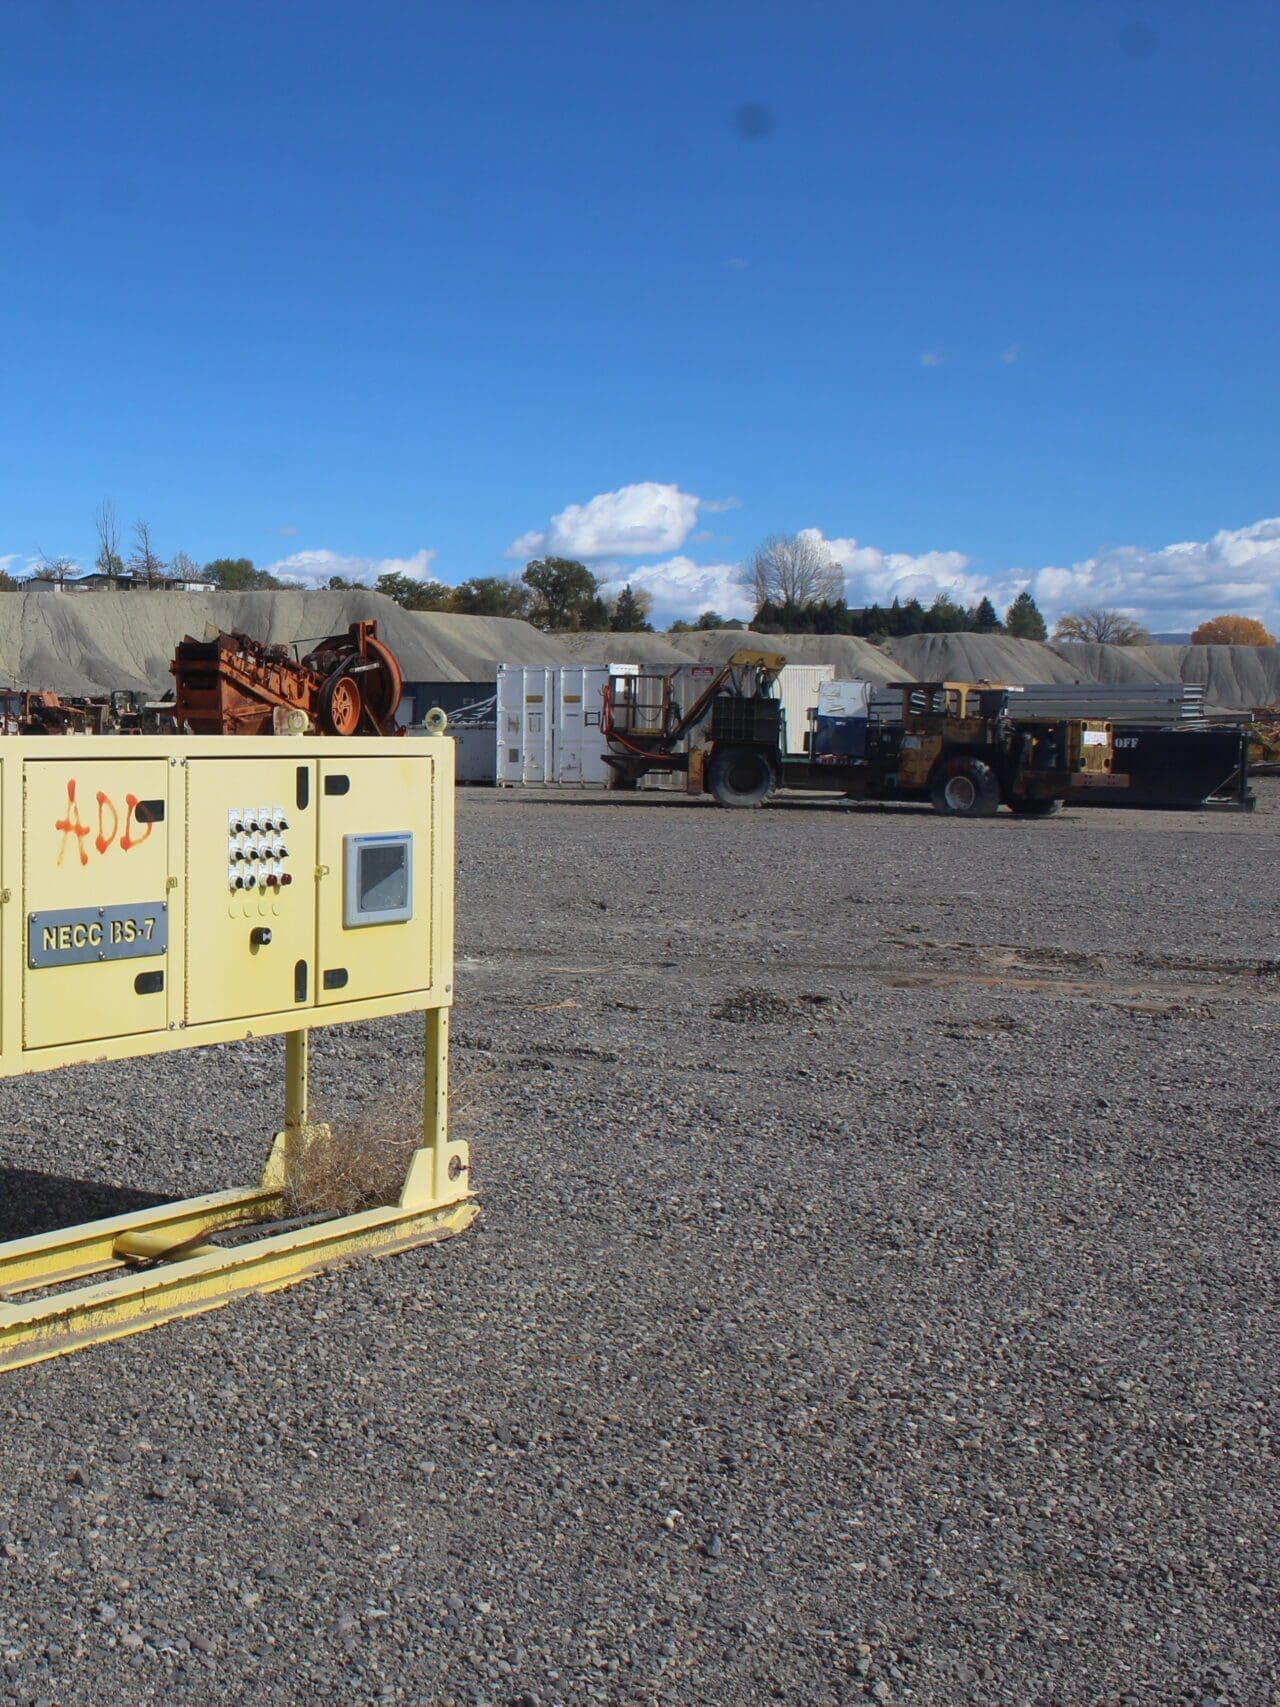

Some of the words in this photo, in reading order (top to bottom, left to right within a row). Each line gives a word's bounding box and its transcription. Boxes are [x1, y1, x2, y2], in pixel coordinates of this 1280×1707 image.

[55, 778, 153, 866] ADD
[43, 921, 104, 951] NECC
[110, 917, 156, 944] BS-7
